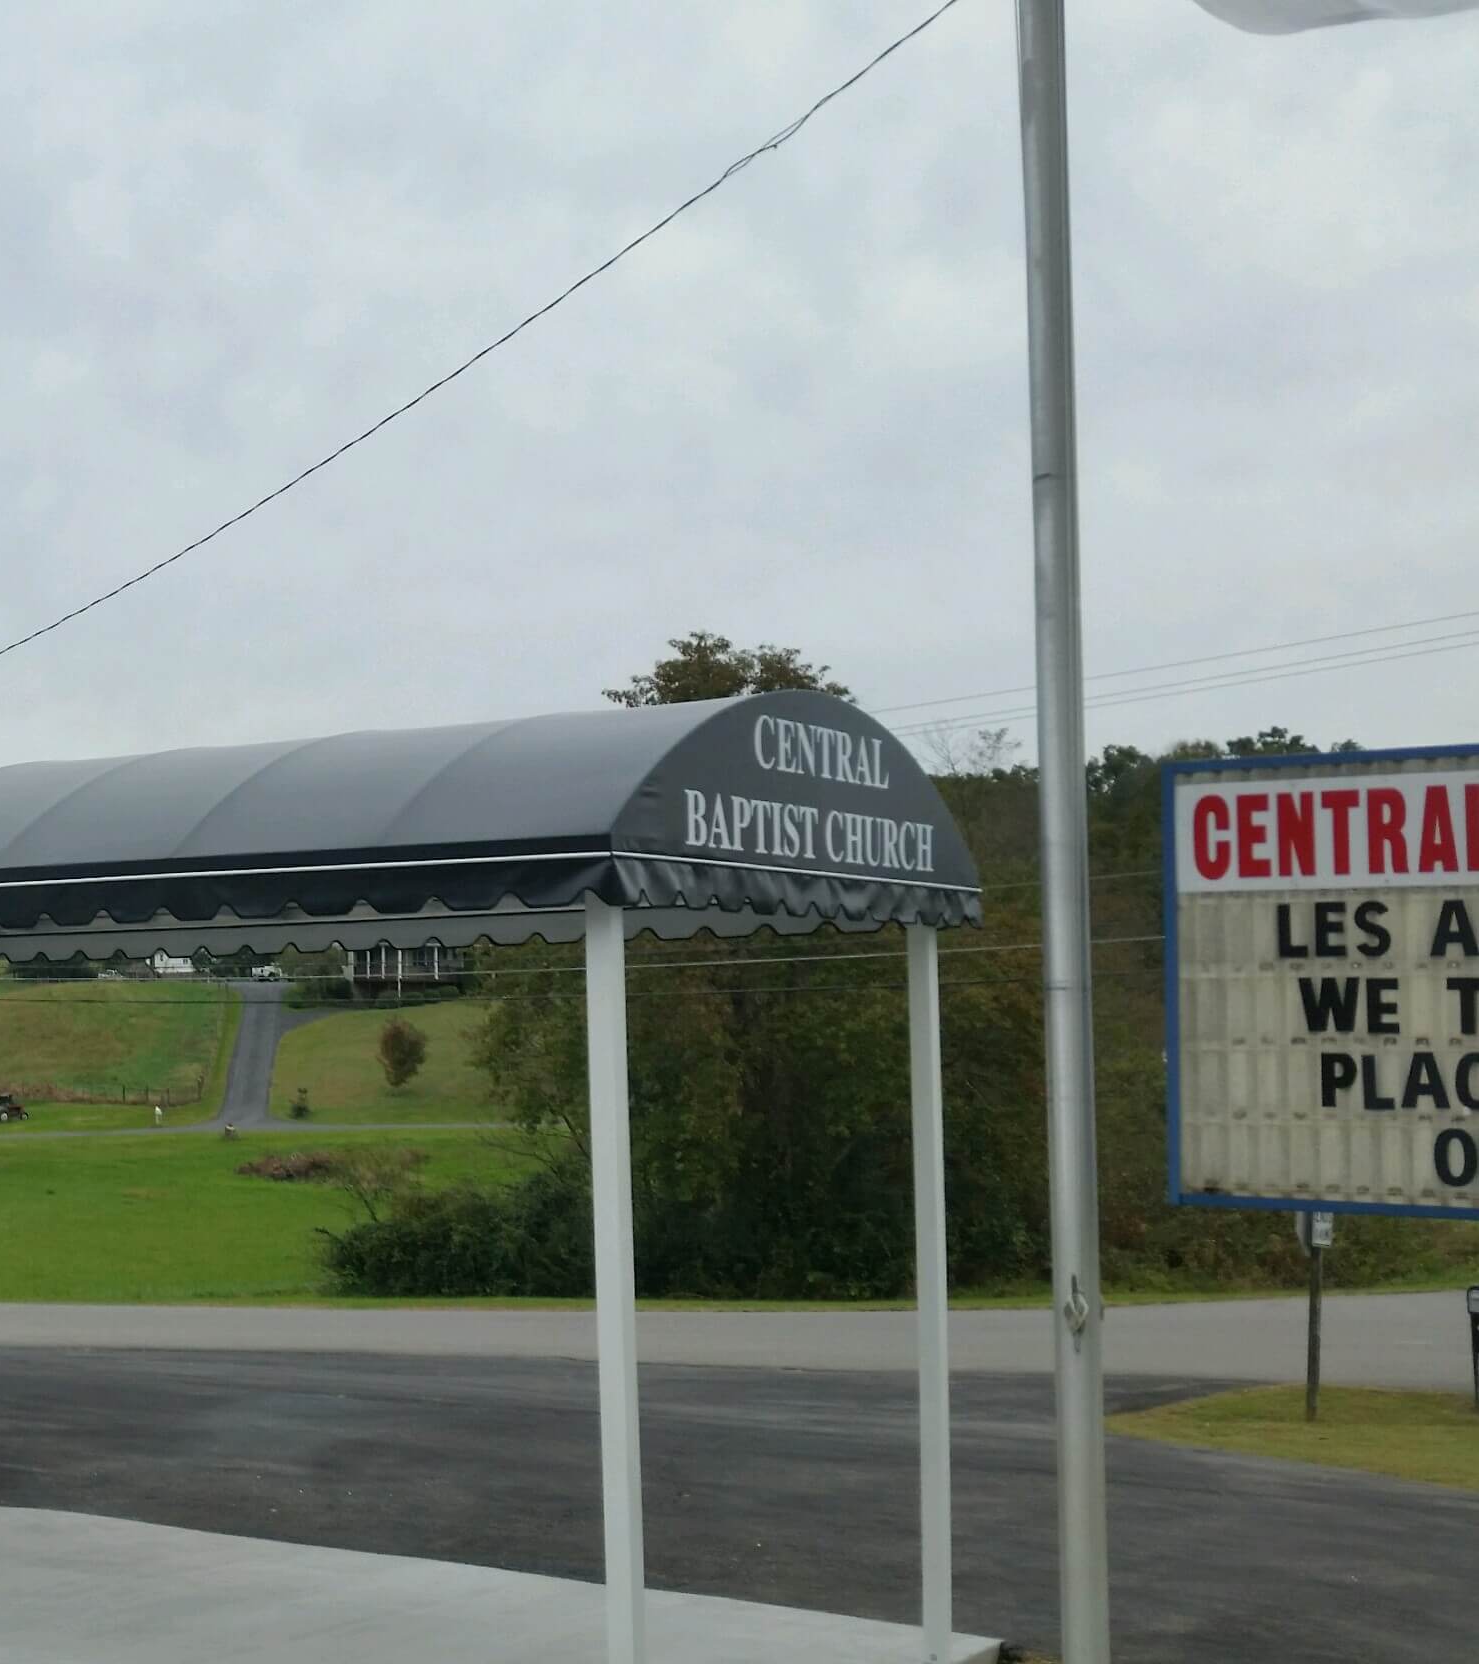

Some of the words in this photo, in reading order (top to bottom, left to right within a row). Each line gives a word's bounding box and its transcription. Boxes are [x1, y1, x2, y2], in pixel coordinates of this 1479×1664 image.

[754, 715, 889, 789] CENTRAL
[684, 789, 818, 859] BAPTIST
[825, 810, 934, 872] CHURCH
[1277, 901, 1392, 959] LES
[1298, 976, 1401, 1035] WE
